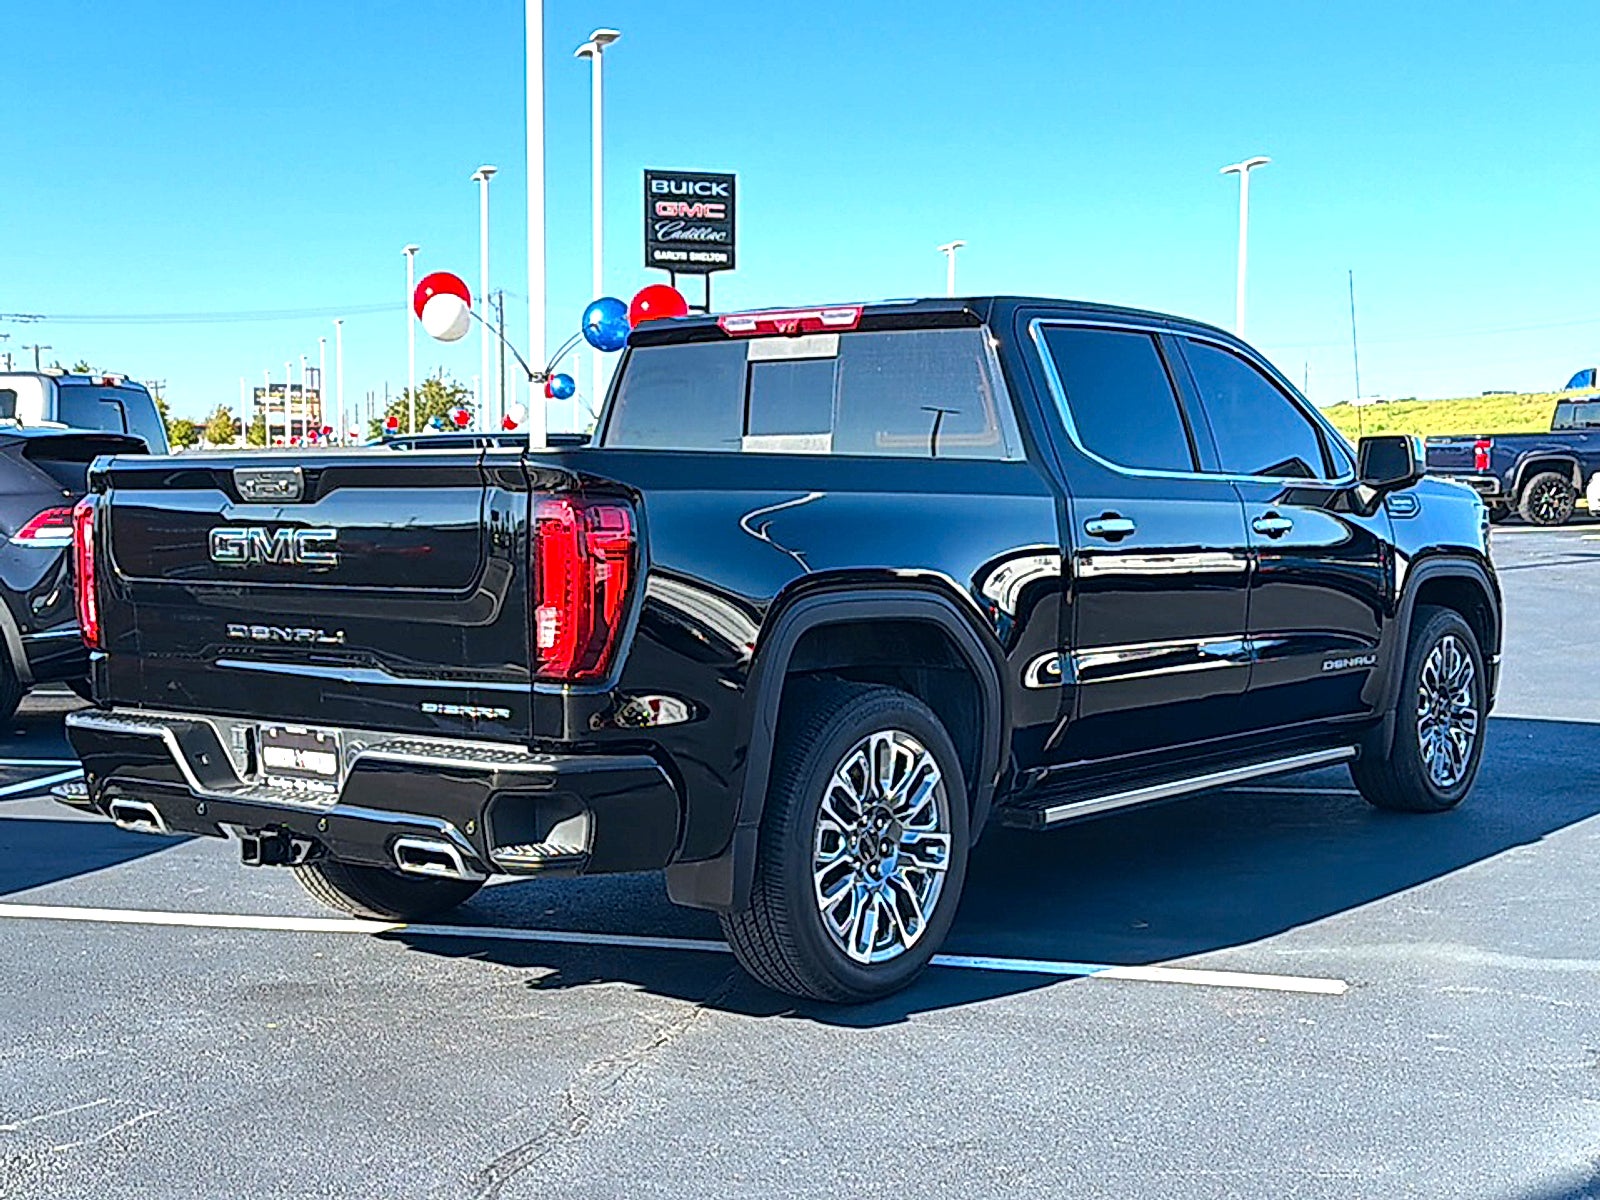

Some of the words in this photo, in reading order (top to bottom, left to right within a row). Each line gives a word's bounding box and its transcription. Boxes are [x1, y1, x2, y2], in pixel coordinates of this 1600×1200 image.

[651, 179, 730, 197] BUICK
[655, 201, 726, 219] GMC
[654, 220, 727, 242] Cadillac
[208, 526, 339, 566] GMC
[226, 623, 346, 643] DENALI
